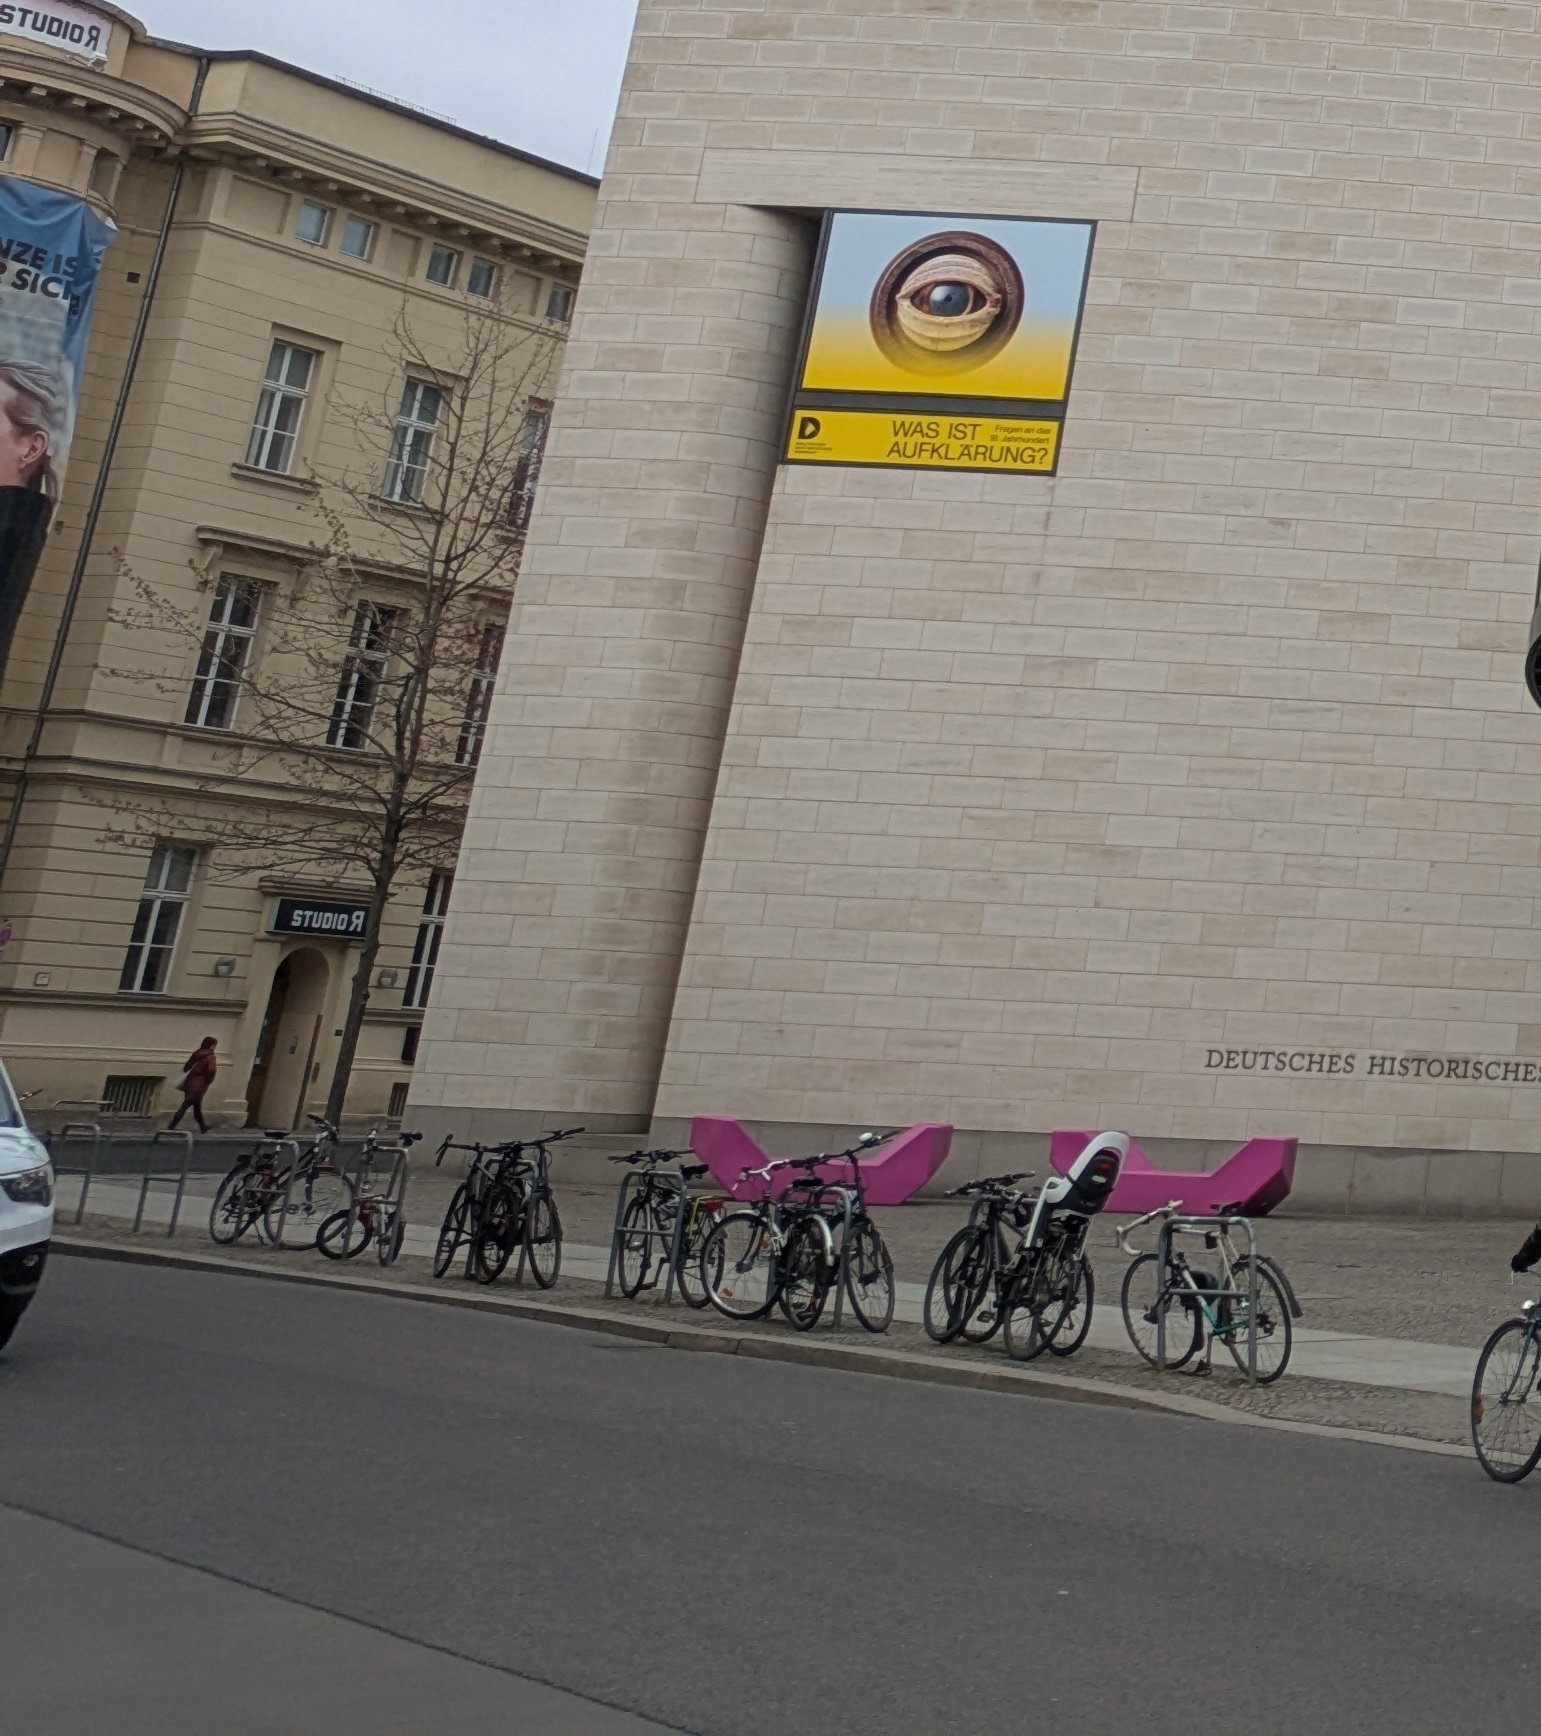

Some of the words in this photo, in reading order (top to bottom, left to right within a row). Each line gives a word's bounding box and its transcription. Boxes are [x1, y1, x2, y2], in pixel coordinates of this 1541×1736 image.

[892, 420, 940, 439] WAS
[947, 423, 982, 441] IST
[886, 441, 1049, 465] AUFKLÄRUNG?
[1205, 1049, 1356, 1075] DEUTSCHES
